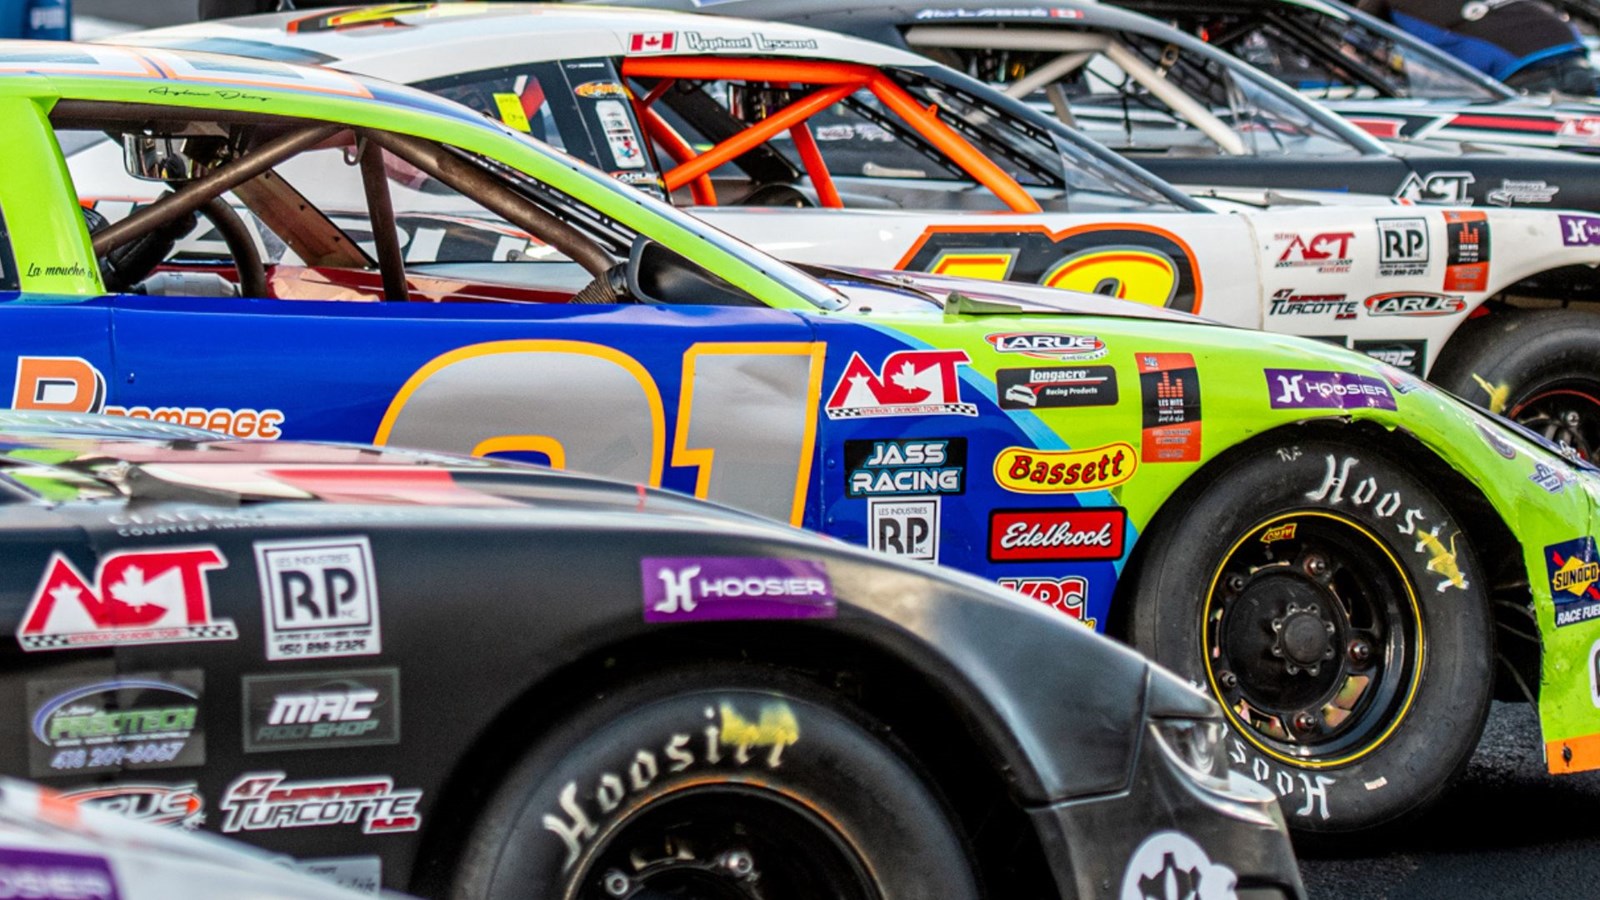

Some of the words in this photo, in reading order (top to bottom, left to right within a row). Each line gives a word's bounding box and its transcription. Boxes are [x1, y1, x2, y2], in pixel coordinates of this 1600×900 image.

[685, 31, 752, 50] Raphael
[752, 32, 818, 51] Lessard
[1278, 232, 1355, 262] ACT
[1384, 229, 1424, 258] RP
[26, 263, 41, 277] La
[1368, 296, 1463, 316] LARUE
[996, 336, 1097, 352] LARUE
[828, 350, 971, 408] ACT
[1029, 369, 1087, 383] Longacre
[1045, 388, 1068, 396] Racing
[1305, 382, 1389, 397] HOOSIER
[867, 443, 945, 466] JASS
[1008, 449, 1124, 485] Bassett
[852, 469, 959, 492] RACING
[879, 508, 890, 516] LES
[890, 506, 928, 515] INDUSTRIES
[878, 517, 930, 554] RP
[1000, 521, 1112, 549] Edelbrock
[700, 578, 827, 598] HOOSIER
[1556, 566, 1598, 588] SUNOCO
[22, 549, 224, 634] ACT
[279, 567, 358, 621] RP
[1557, 610, 1581, 625] RACE
[1583, 603, 1600, 618] FUE
[268, 691, 379, 725] MAC
[309, 720, 380, 738] SHOP
[98, 786, 193, 816] RUE
[225, 791, 416, 830] TURCOTTE
